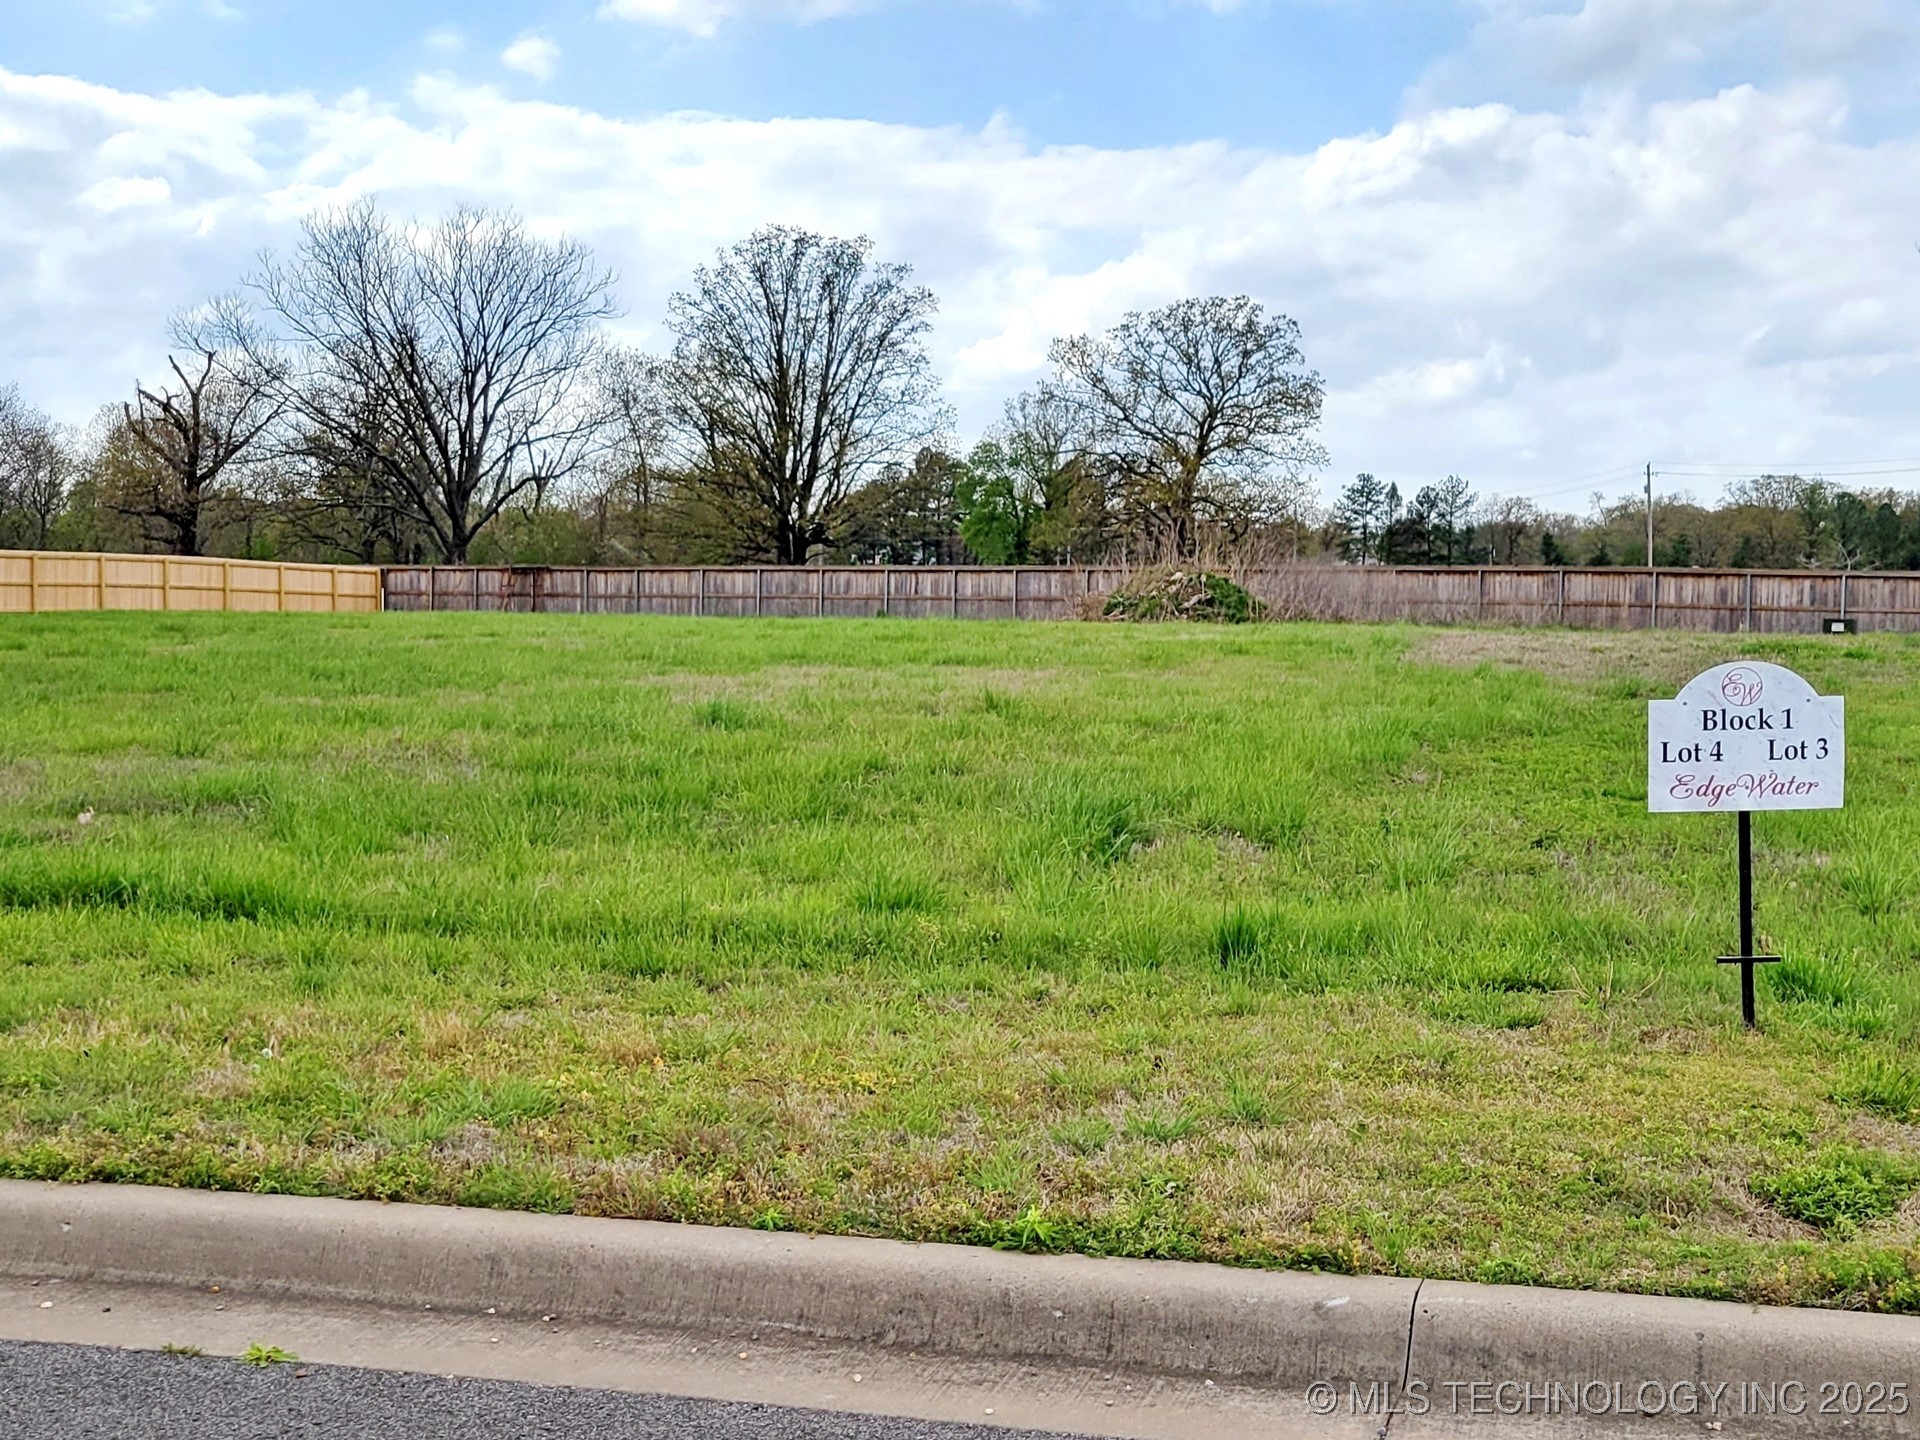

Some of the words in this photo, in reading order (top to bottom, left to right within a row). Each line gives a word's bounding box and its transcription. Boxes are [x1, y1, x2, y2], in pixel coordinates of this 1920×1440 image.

[1701, 708, 1774, 731] Block
[1781, 708, 1794, 730] 1
[1660, 741, 1702, 763] Lot
[1709, 740, 1724, 762] 4
[1767, 738, 1808, 761] Lot
[1815, 737, 1829, 760] 3
